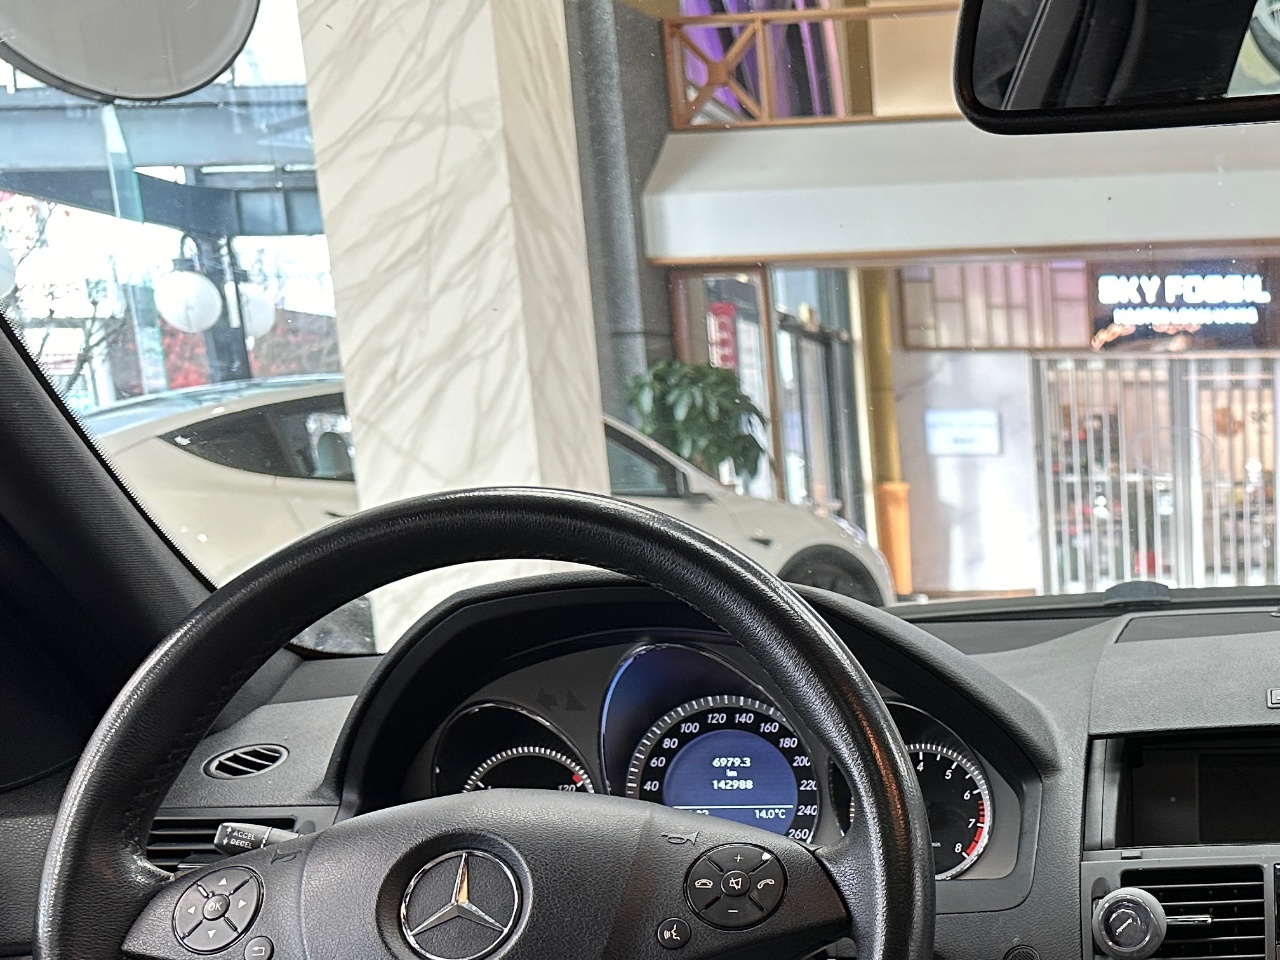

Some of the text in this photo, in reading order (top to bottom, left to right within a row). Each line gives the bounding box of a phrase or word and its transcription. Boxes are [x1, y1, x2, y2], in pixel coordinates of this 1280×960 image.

[707, 713, 727, 724] 120
[734, 713, 754, 724] 140
[680, 722, 700, 733] 100
[760, 722, 780, 733] 160
[662, 738, 678, 749] 80
[778, 737, 798, 748] 180
[650, 756, 666, 767] 60
[712, 757, 751, 768] 6979.3
[917, 762, 924, 772] 4
[944, 770, 952, 780] 5
[644, 780, 660, 791] 40
[712, 780, 754, 790] 142988
[963, 790, 970, 800] 6
[755, 809, 786, 819] 14.0°C
[797, 805, 818, 816] 240
[968, 818, 976, 828] 7
[232, 830, 256, 840] ACCEL
[788, 829, 809, 839] 260
[230, 839, 252, 849] DECEL
[954, 843, 962, 853] 8
[208, 901, 222, 911] OK
